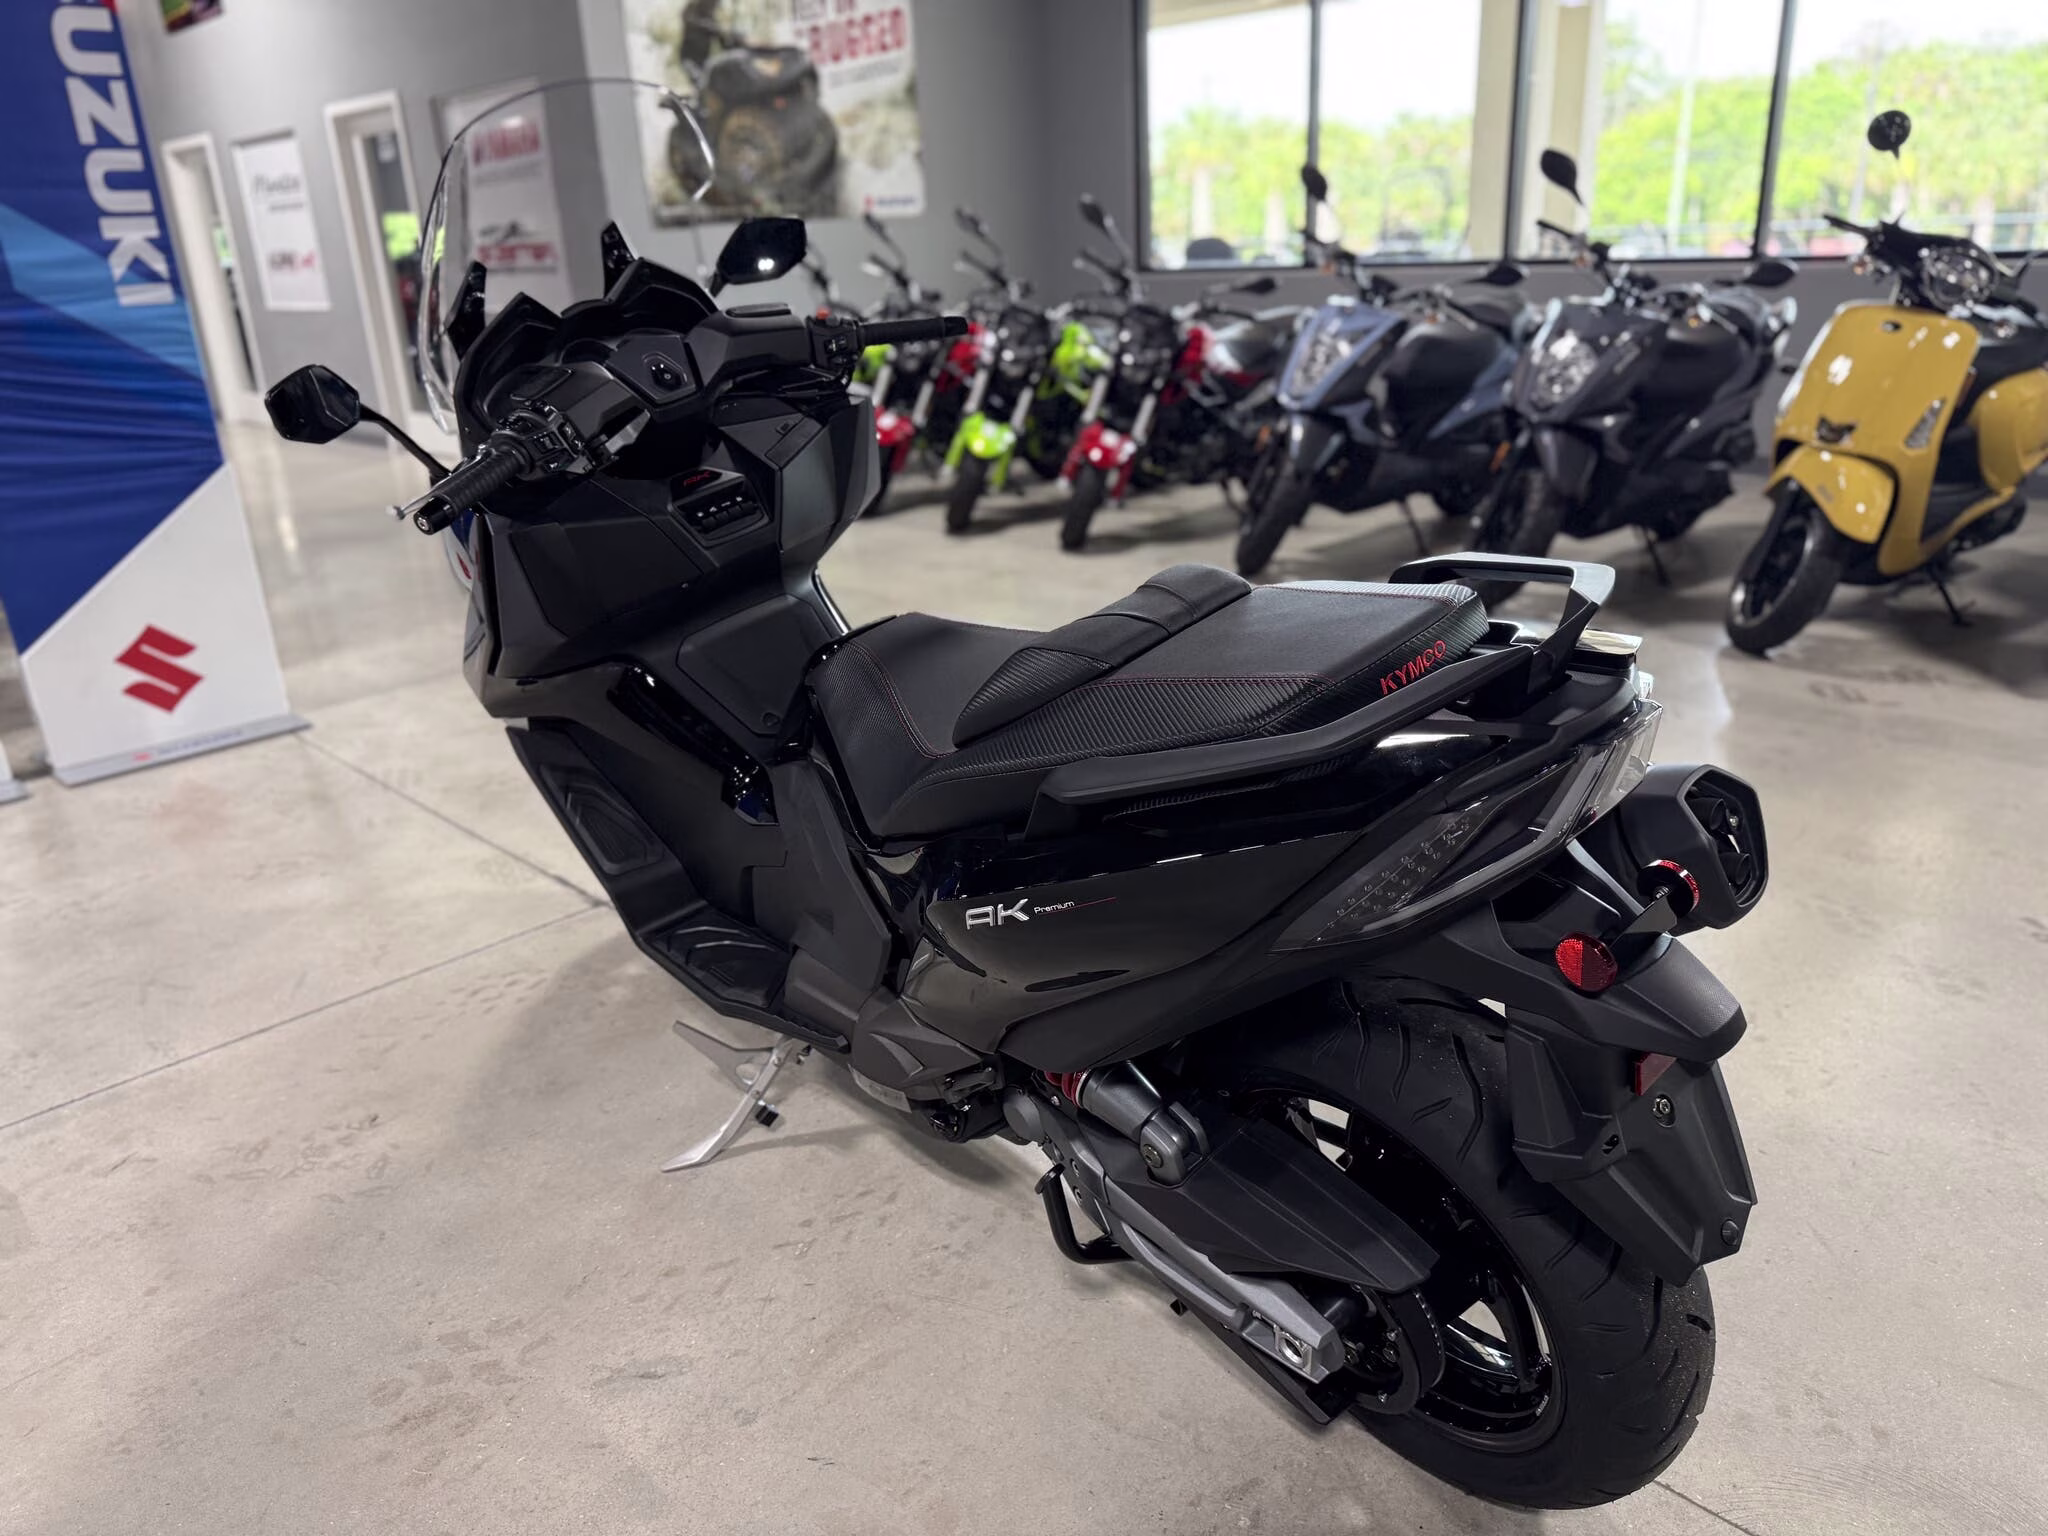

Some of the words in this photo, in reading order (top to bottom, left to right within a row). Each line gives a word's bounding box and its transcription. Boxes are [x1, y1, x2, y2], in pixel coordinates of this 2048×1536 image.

[50, 0, 176, 306] UZUKI
[1380, 640, 1446, 695] KYMCO
[965, 898, 1030, 930] AK
[1034, 901, 1075, 914] Premium
